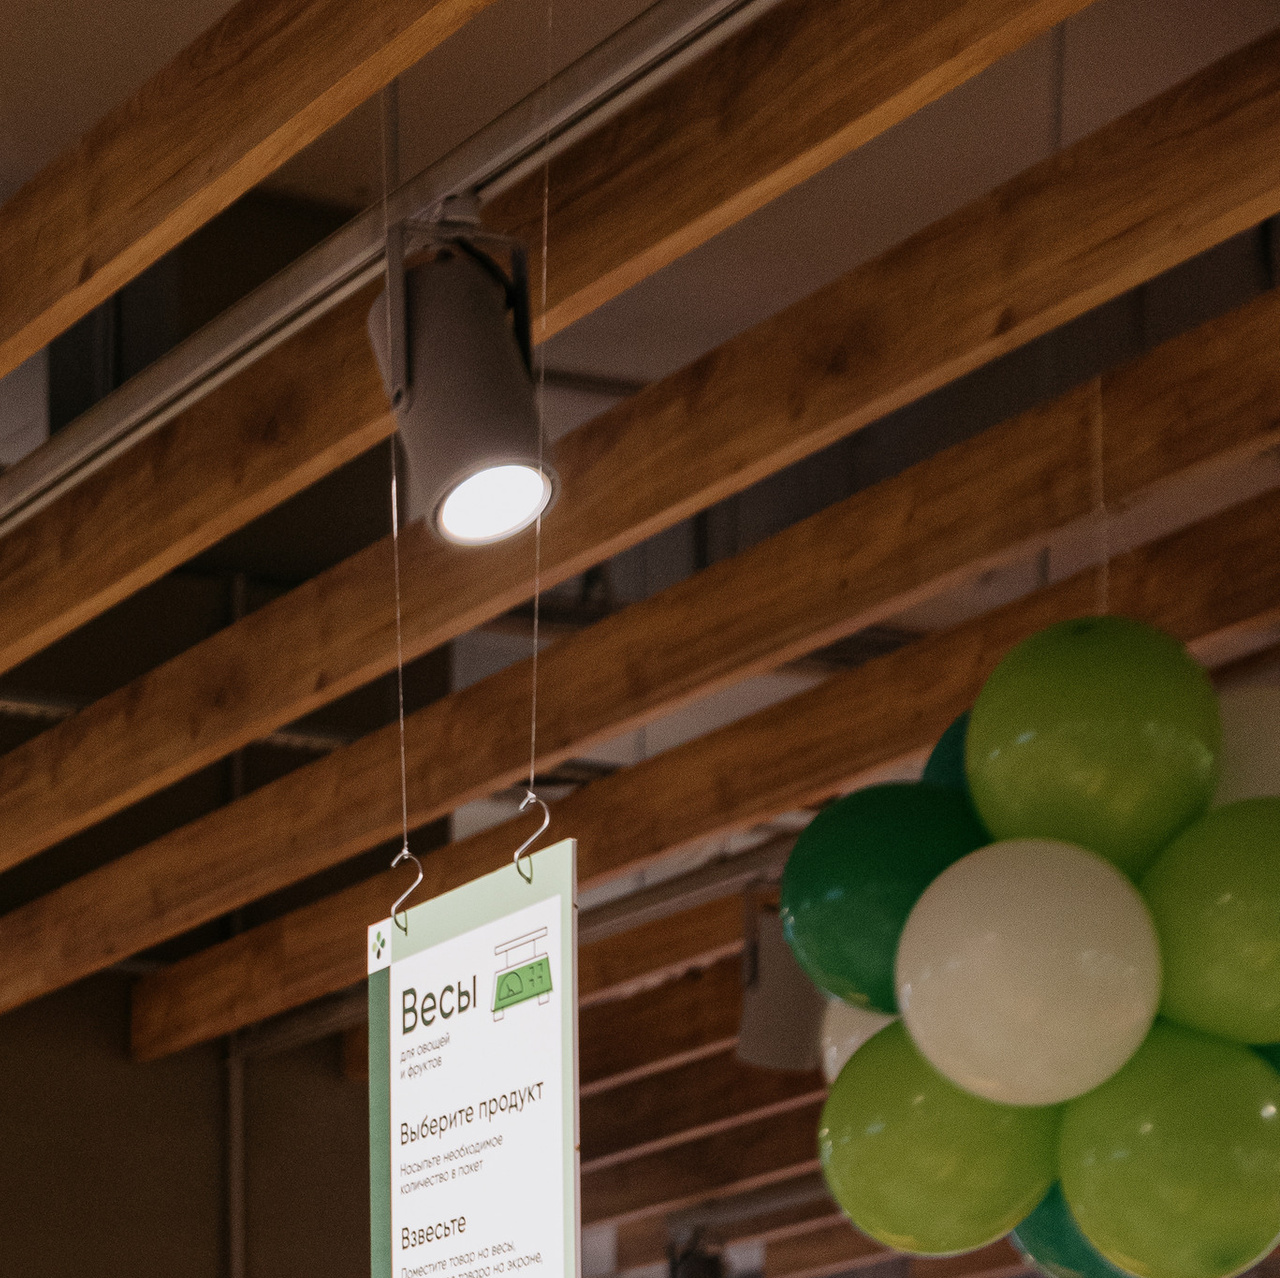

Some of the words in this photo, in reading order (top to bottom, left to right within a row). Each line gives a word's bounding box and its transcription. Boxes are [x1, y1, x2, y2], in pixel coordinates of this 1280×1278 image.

[402, 974, 477, 1036] Весы
[400, 1047, 415, 1064] для
[417, 1032, 450, 1056] овощей
[400, 1069, 406, 1080] и
[407, 1056, 442, 1081] фруктов
[400, 1106, 474, 1146] Выберите
[478, 1081, 544, 1123] продукт
[400, 1154, 441, 1177] Насыпьте
[443, 1134, 503, 1162] необходимое
[400, 1171, 449, 1195] количество
[451, 1168, 456, 1179] в
[458, 1160, 484, 1176] пакет
[401, 1216, 467, 1250] Взвесьте
[449, 1251, 476, 1269] товар
[477, 1247, 489, 1260] на
[493, 1262, 505, 1274] на
[507, 1252, 544, 1271] экране,
